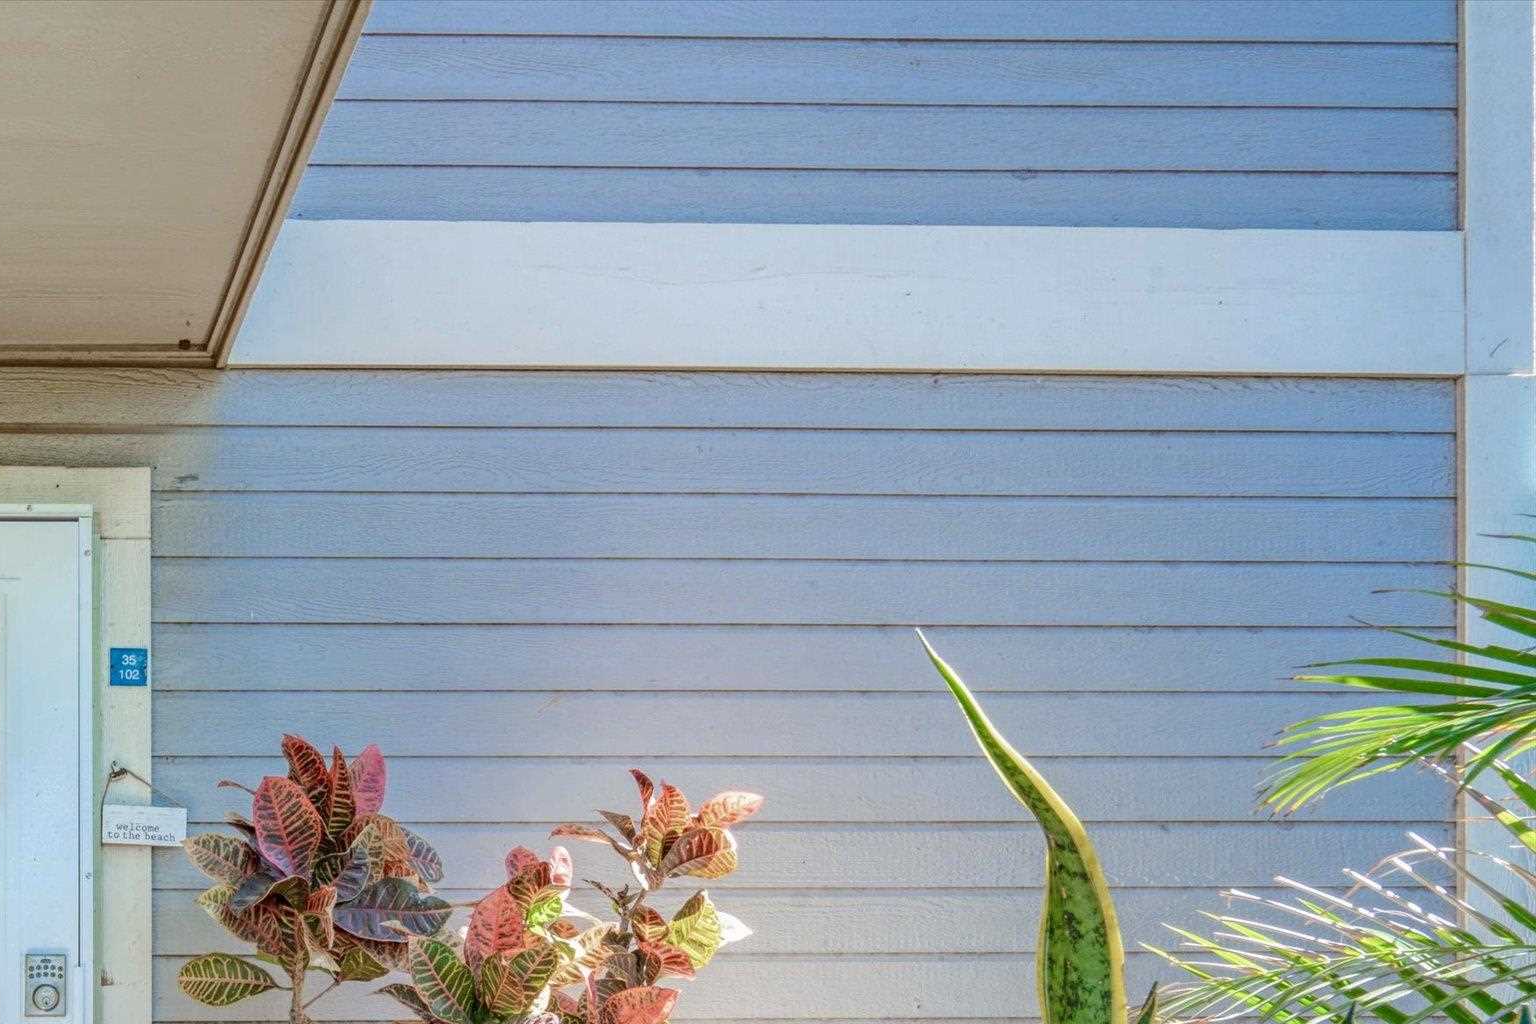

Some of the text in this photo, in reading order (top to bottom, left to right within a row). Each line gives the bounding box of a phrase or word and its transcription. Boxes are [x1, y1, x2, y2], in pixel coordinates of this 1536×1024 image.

[119, 669, 140, 680] 102
[115, 822, 160, 833] welcome
[108, 831, 176, 842] to the beach
